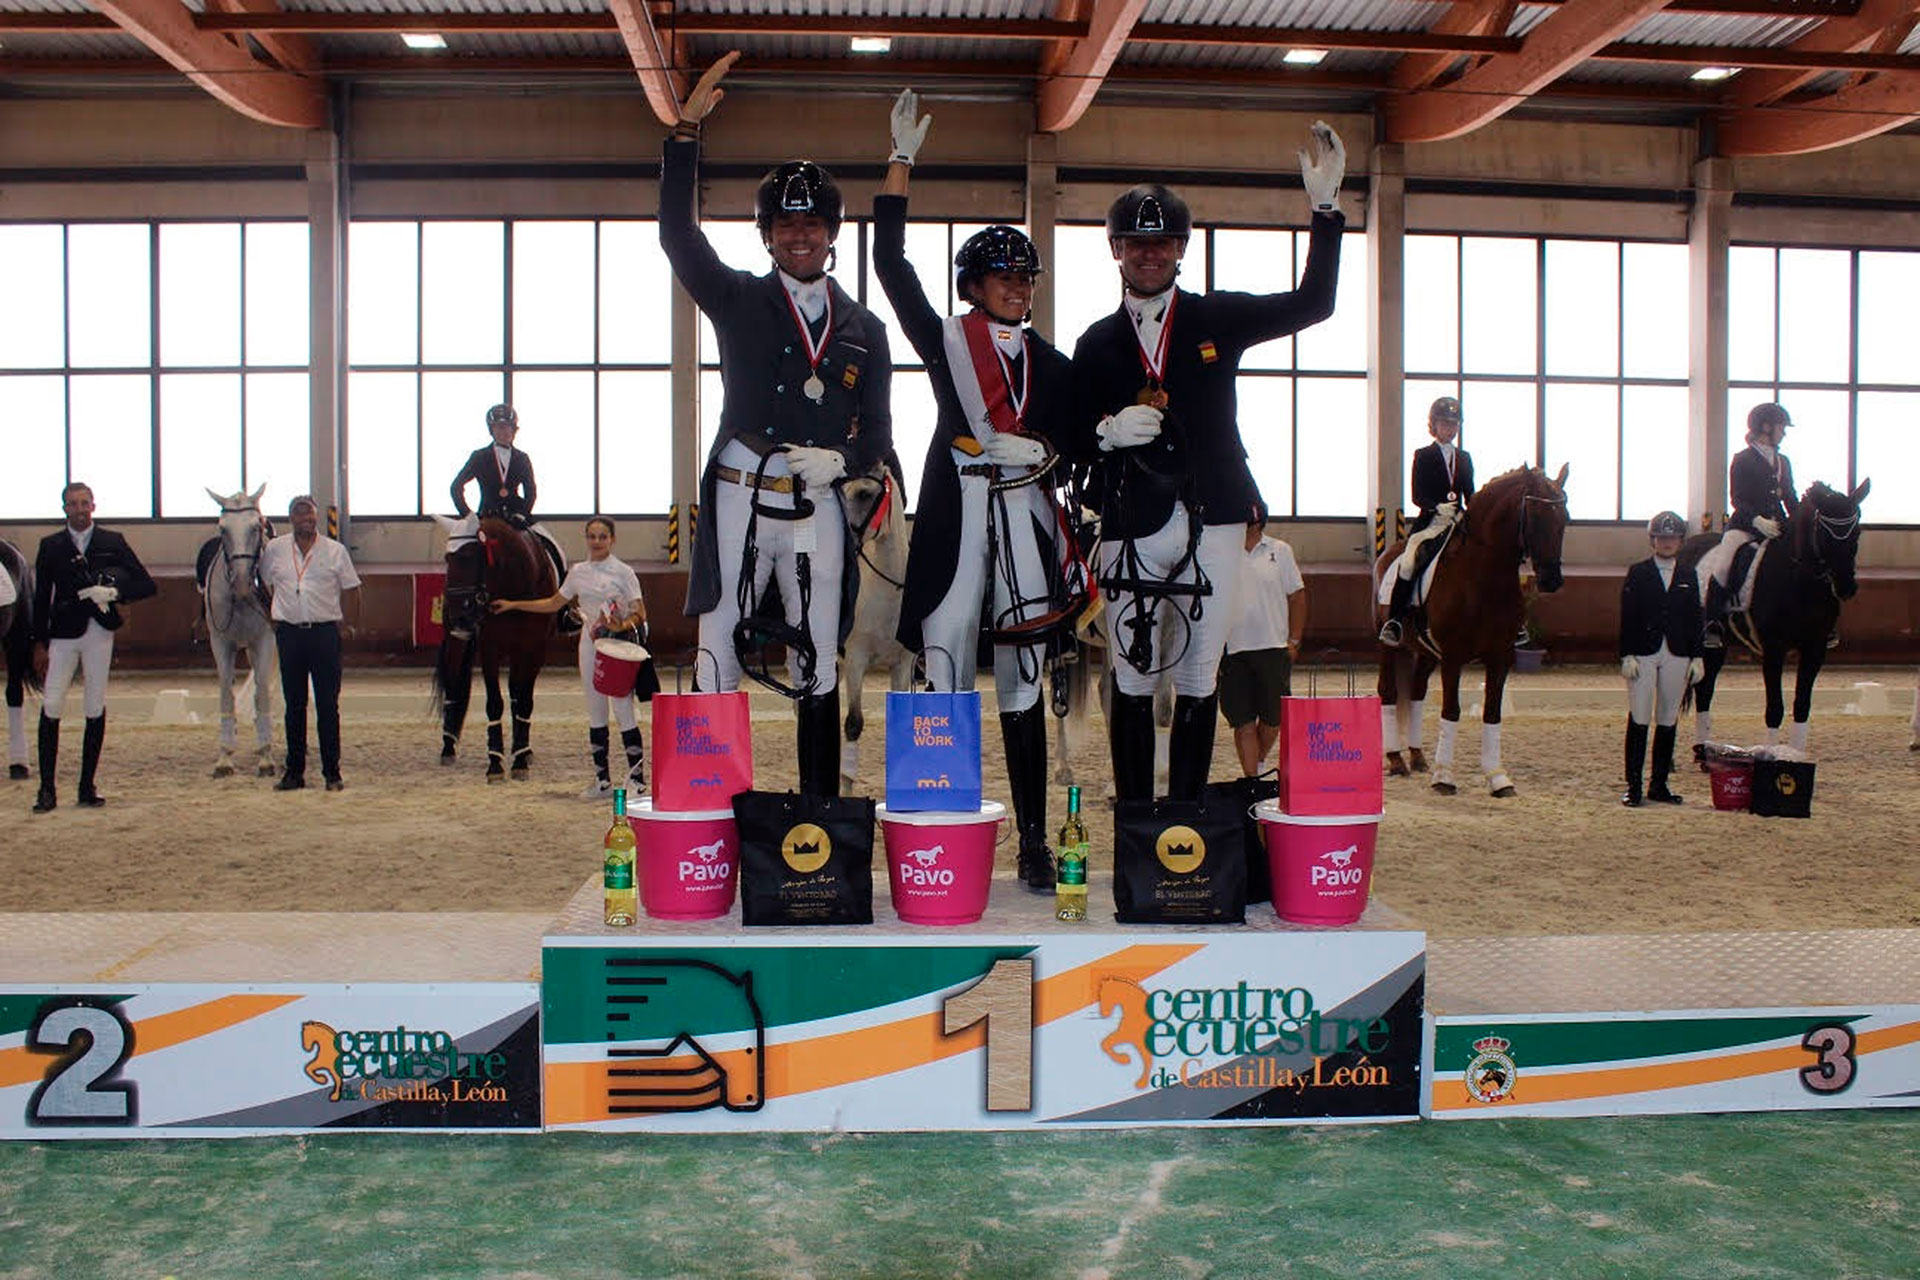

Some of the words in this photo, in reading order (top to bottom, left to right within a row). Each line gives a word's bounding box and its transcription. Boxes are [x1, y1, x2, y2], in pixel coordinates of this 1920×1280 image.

[912, 715, 950, 727] BACK
[913, 726, 931, 737] TO
[1307, 722, 1343, 733] BACK
[912, 735, 954, 746] WORK
[1308, 741, 1344, 752] YOUR
[1308, 749, 1363, 762] FRIENDS
[679, 861, 730, 881] Pavo
[900, 863, 955, 886] Pavo
[1311, 865, 1363, 886] Pavo
[1145, 980, 1314, 1021] centro
[333, 1025, 453, 1054] centro
[943, 958, 1033, 1112] 1
[1144, 1010, 1390, 1057] ecuestre
[34, 1003, 131, 1119] 2
[333, 1045, 507, 1080] ecuestre
[1802, 1025, 1854, 1093] 3
[1150, 1067, 1177, 1088] de
[1180, 1058, 1294, 1088] Castilla
[1294, 1074, 1310, 1095] y
[1311, 1055, 1390, 1087] León
[360, 1079, 440, 1101] Castilla
[440, 1092, 451, 1107] y
[451, 1079, 508, 1102] León
